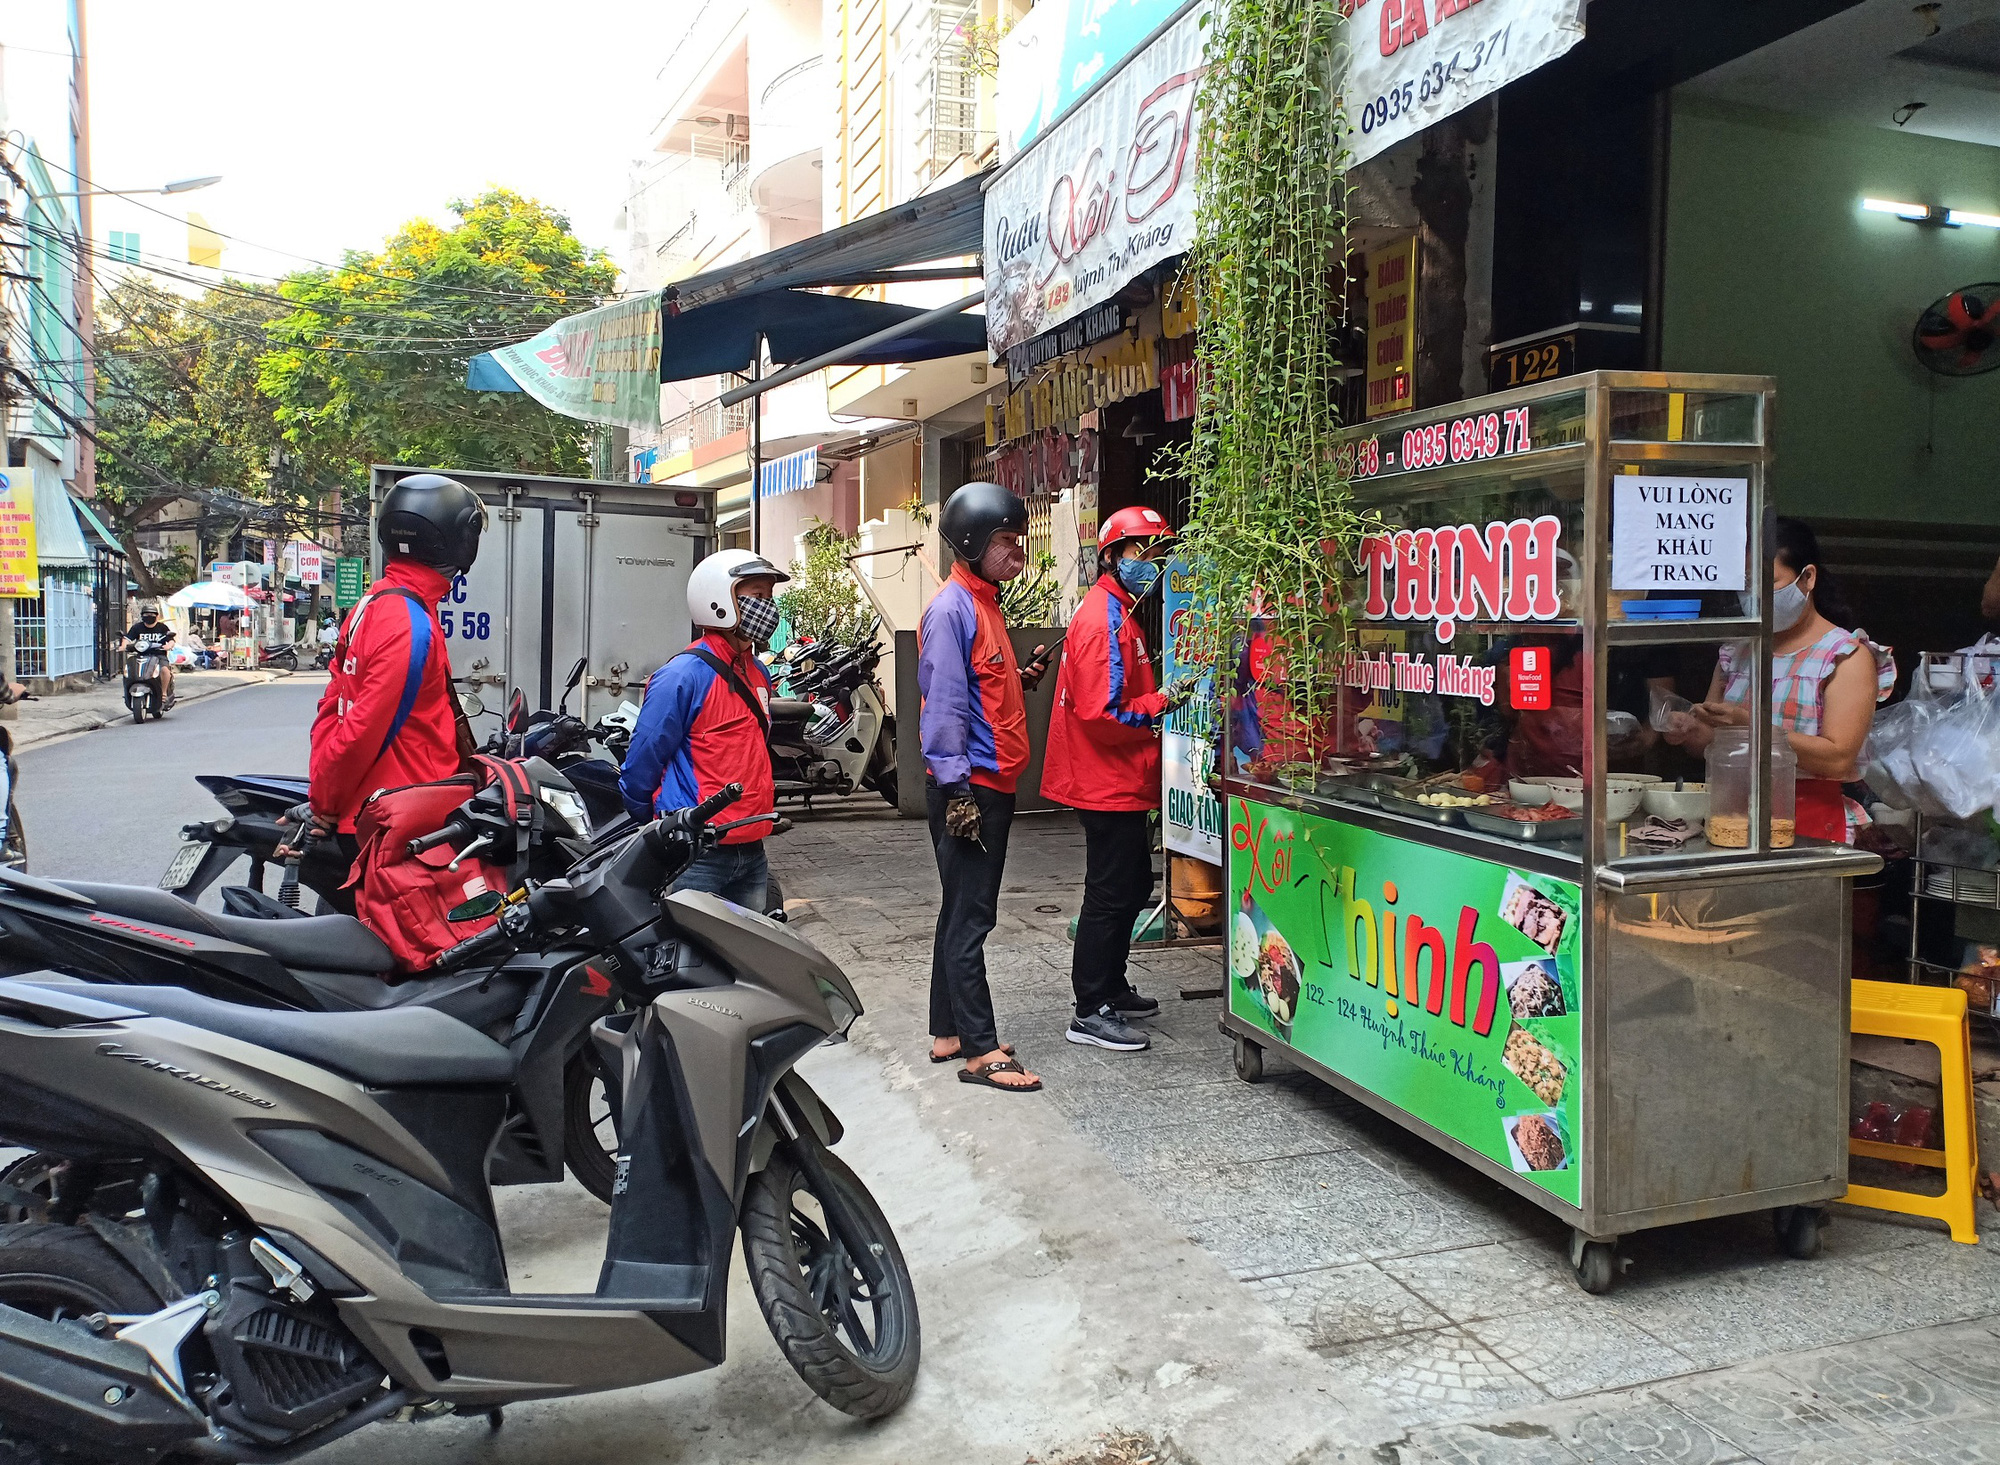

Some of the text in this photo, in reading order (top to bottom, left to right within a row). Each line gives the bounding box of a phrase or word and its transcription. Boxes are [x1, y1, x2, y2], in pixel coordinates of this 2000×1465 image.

[1361, 79, 1414, 134] 0935
[1466, 20, 1513, 73] 371
[1506, 344, 1560, 386] 122
[1401, 422, 1447, 471] 0935
[1449, 412, 1499, 463] 6343
[1503, 406, 1531, 455] 71
[1638, 482, 1733, 505] VUI LÒNG
[1655, 512, 1715, 530] MANG
[299, 542, 321, 552] THANH
[1656, 534, 1713, 556] KHẨU
[300, 556, 320, 566] CƠM
[615, 555, 676, 568] TOWNER
[1650, 564, 1719, 582] TRANG
[1358, 514, 1562, 644] THỊNH
[461, 611, 491, 641] 58
[1391, 652, 1434, 694] Thúc
[1436, 653, 1496, 707] Kháng
[1168, 786, 1194, 831] GIAO
[1231, 800, 1295, 894] Xôi
[687, 996, 744, 1021] HONDA
[1305, 982, 1326, 1006] 122
[1337, 997, 1358, 1021] 124
[1360, 1006, 1408, 1050] Huỳnh
[1410, 1030, 1448, 1069] Thúc
[1451, 1049, 1506, 1109] Kháng
